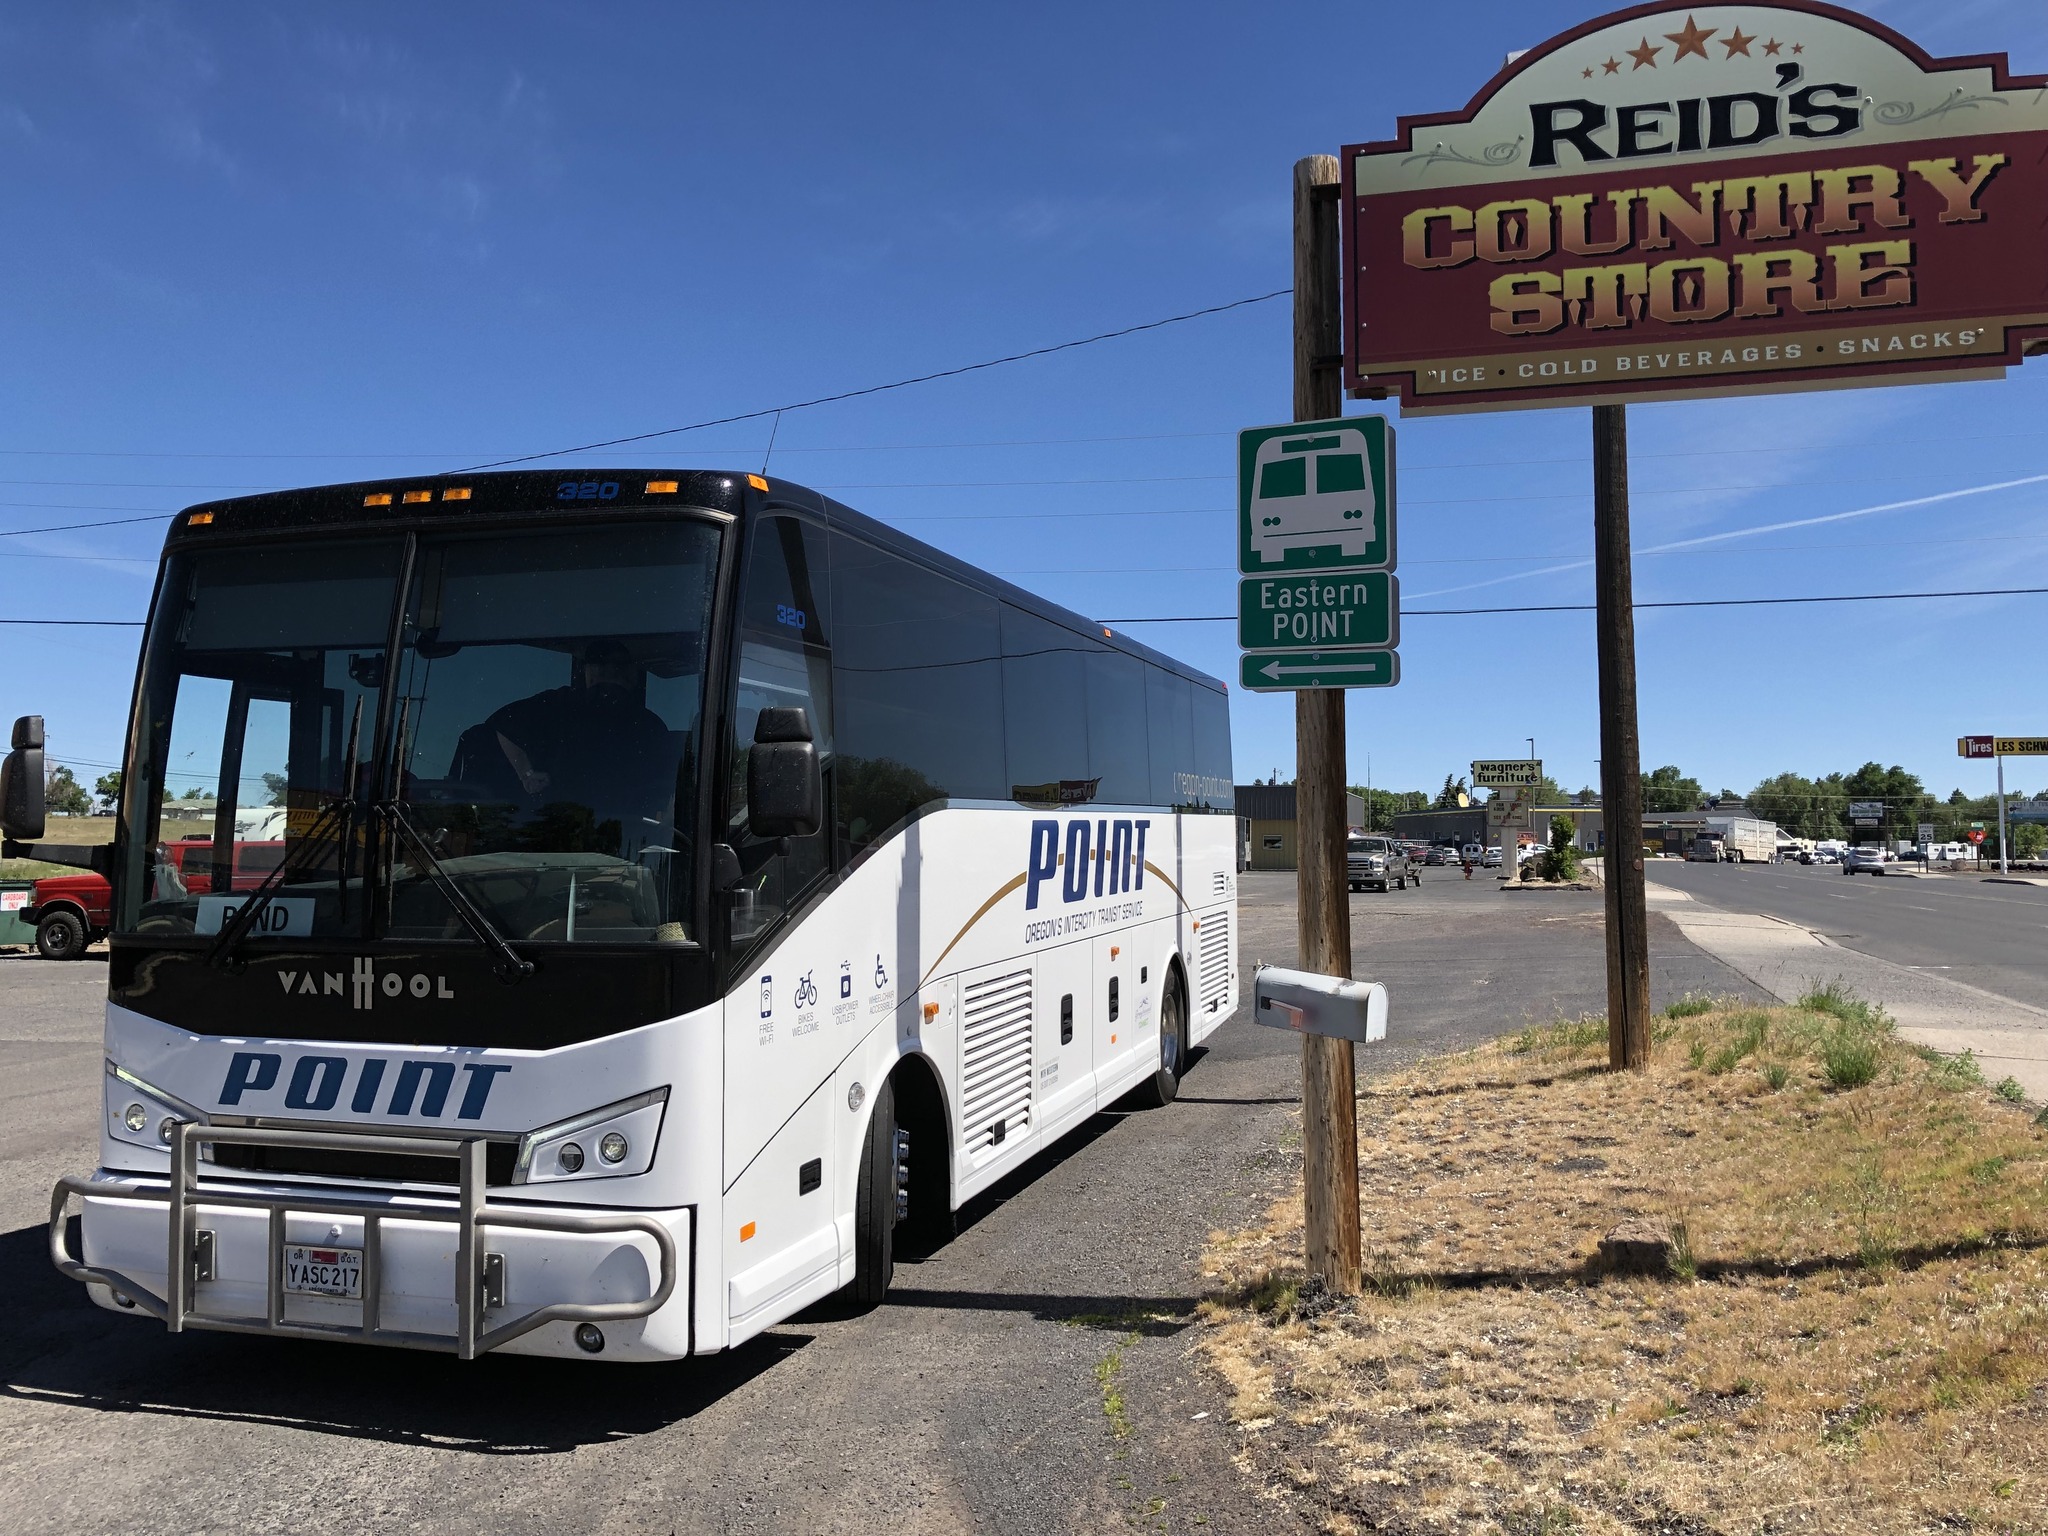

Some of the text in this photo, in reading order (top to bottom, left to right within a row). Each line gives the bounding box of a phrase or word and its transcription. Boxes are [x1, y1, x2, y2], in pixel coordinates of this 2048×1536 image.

[1529, 62, 1861, 168] REID'S
[1402, 153, 2008, 271] COUNTRY
[1490, 239, 1915, 336] STORE
[1440, 330, 1976, 383] ICE COLD BEVERAGES SNACKS
[557, 482, 620, 499] 320
[1261, 582, 1367, 609] Eastern
[776, 604, 806, 630] 320
[1273, 610, 1354, 640] POINT
[1967, 739, 1992, 755] Tires
[1997, 741, 2014, 751] LES
[1477, 772, 1538, 782] furniture
[1480, 763, 1535, 774] wagner's
[1025, 820, 1150, 911] POINT
[221, 906, 289, 931] BND
[1025, 900, 1143, 944] OREGON'S INTERCITY TRANSIT SERVICE
[868, 990, 895, 1004] WHEELCHAIR
[831, 1000, 858, 1016] USB/POWER
[869, 1001, 894, 1015] ACCESSIBLE
[798, 1011, 814, 1025] BIKES
[835, 1011, 856, 1026] OUTLETS
[759, 1022, 774, 1035] FREE
[792, 1021, 820, 1038] WELCOME
[759, 1034, 774, 1046] WI-FI
[218, 1052, 512, 1120] POINT
[293, 1252, 304, 1260] OR
[289, 1263, 360, 1288] YASC217
